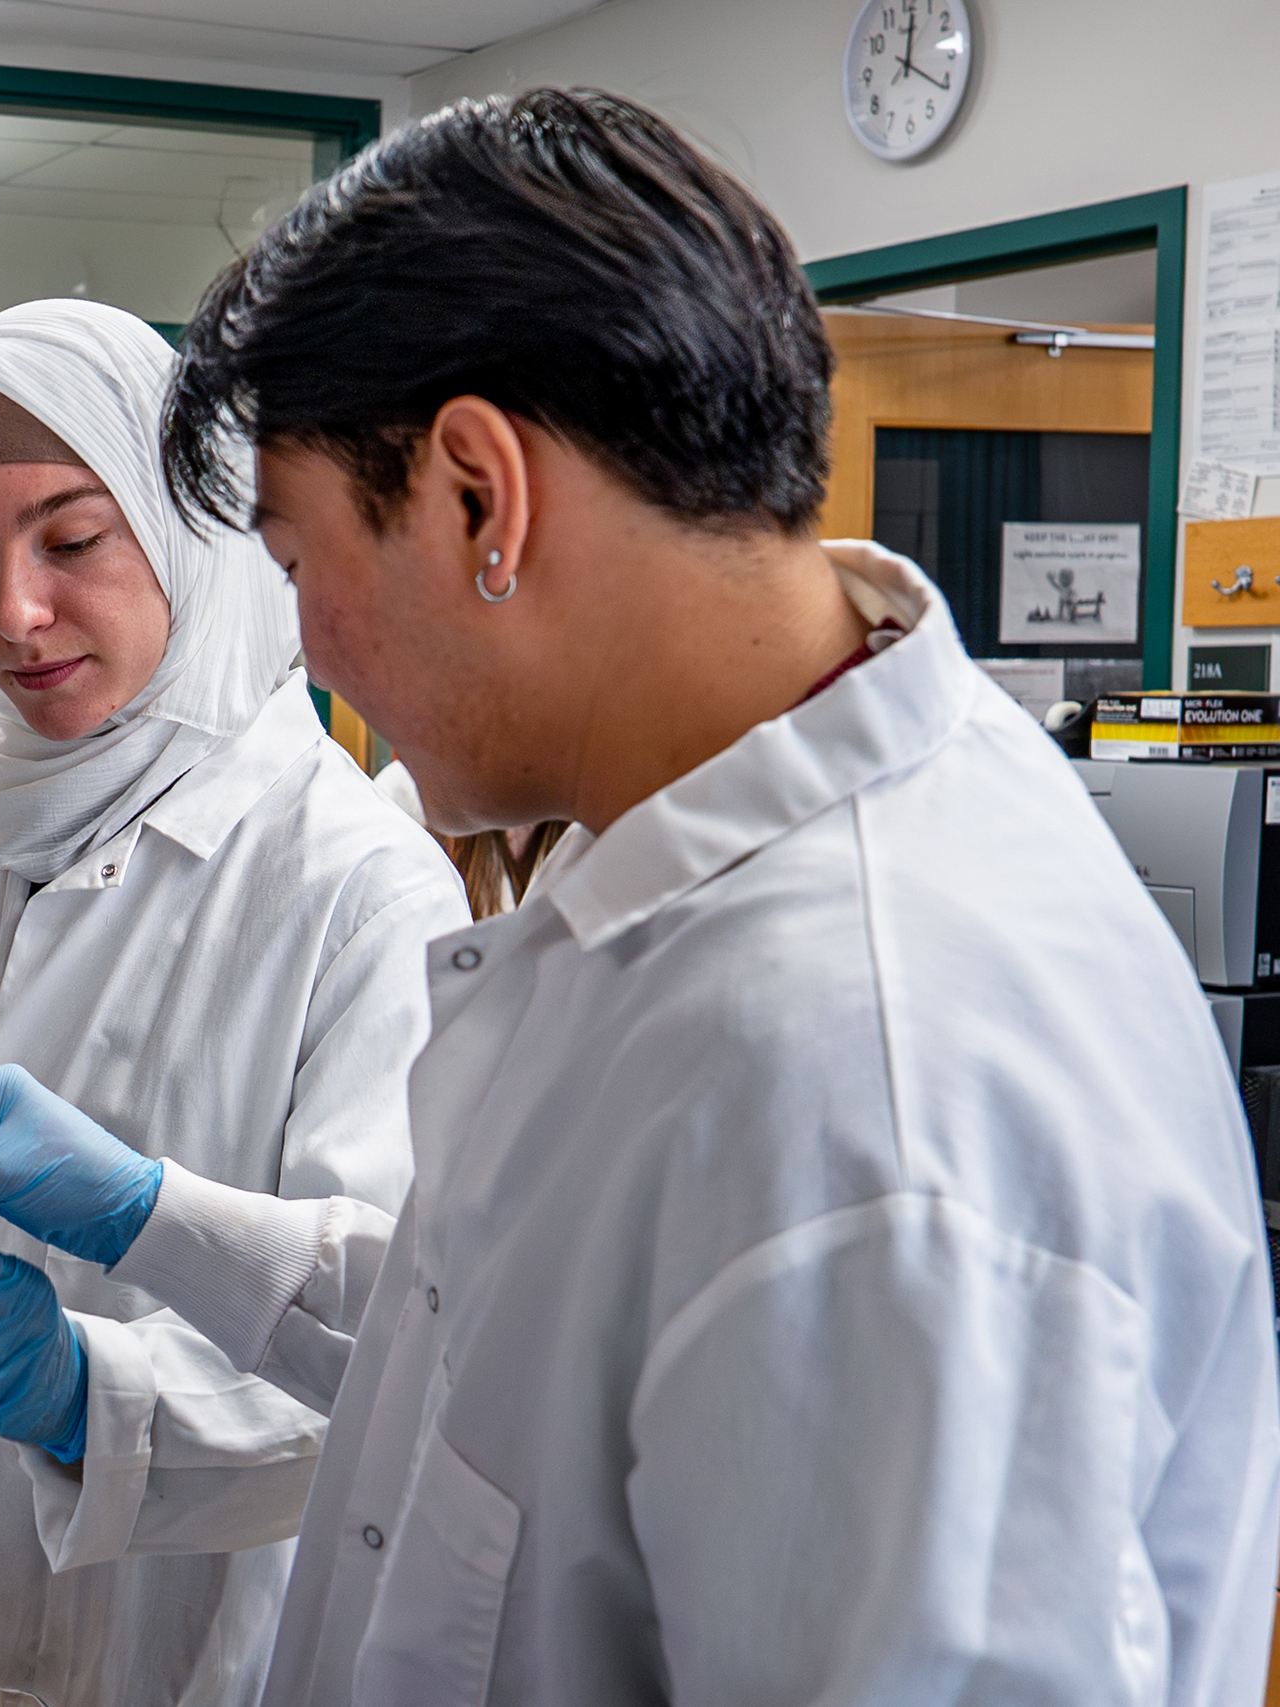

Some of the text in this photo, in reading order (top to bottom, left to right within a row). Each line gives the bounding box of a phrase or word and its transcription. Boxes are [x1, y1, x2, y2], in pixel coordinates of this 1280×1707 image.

[882, 8, 895, 30] 11
[939, 11, 950, 32] 2
[870, 33, 885, 56] 10
[863, 67, 873, 87] 9
[870, 94, 880, 115] 8
[925, 98, 935, 120] 5
[887, 111, 895, 131] 7
[905, 113, 915, 135] 6
[1193, 663, 1223, 679] 218A
[1184, 708, 1264, 724] EVOLUTION ONE
